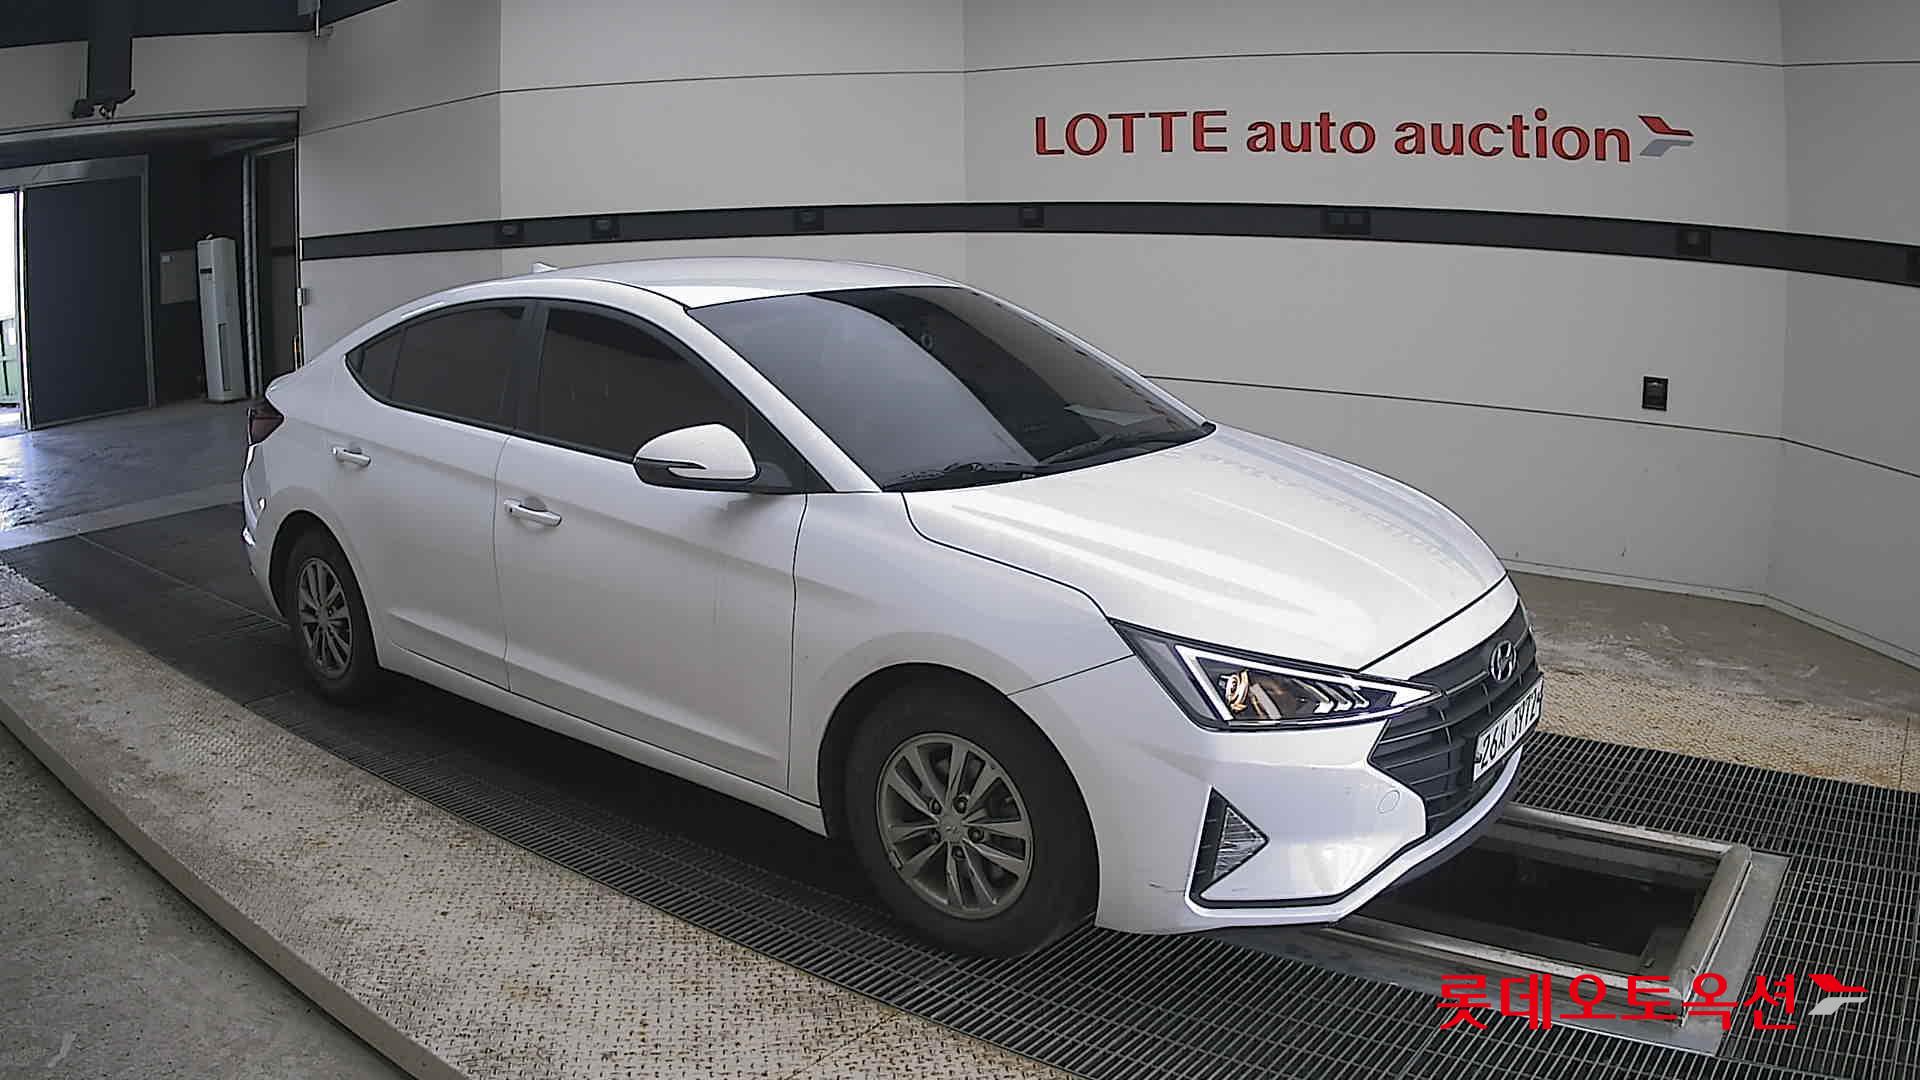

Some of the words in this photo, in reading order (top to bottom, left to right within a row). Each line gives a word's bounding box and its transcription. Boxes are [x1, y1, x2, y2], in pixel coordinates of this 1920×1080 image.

[1035, 110, 1228, 156] LOTTE
[1246, 111, 1376, 154] auto
[1394, 107, 1631, 163] auction
